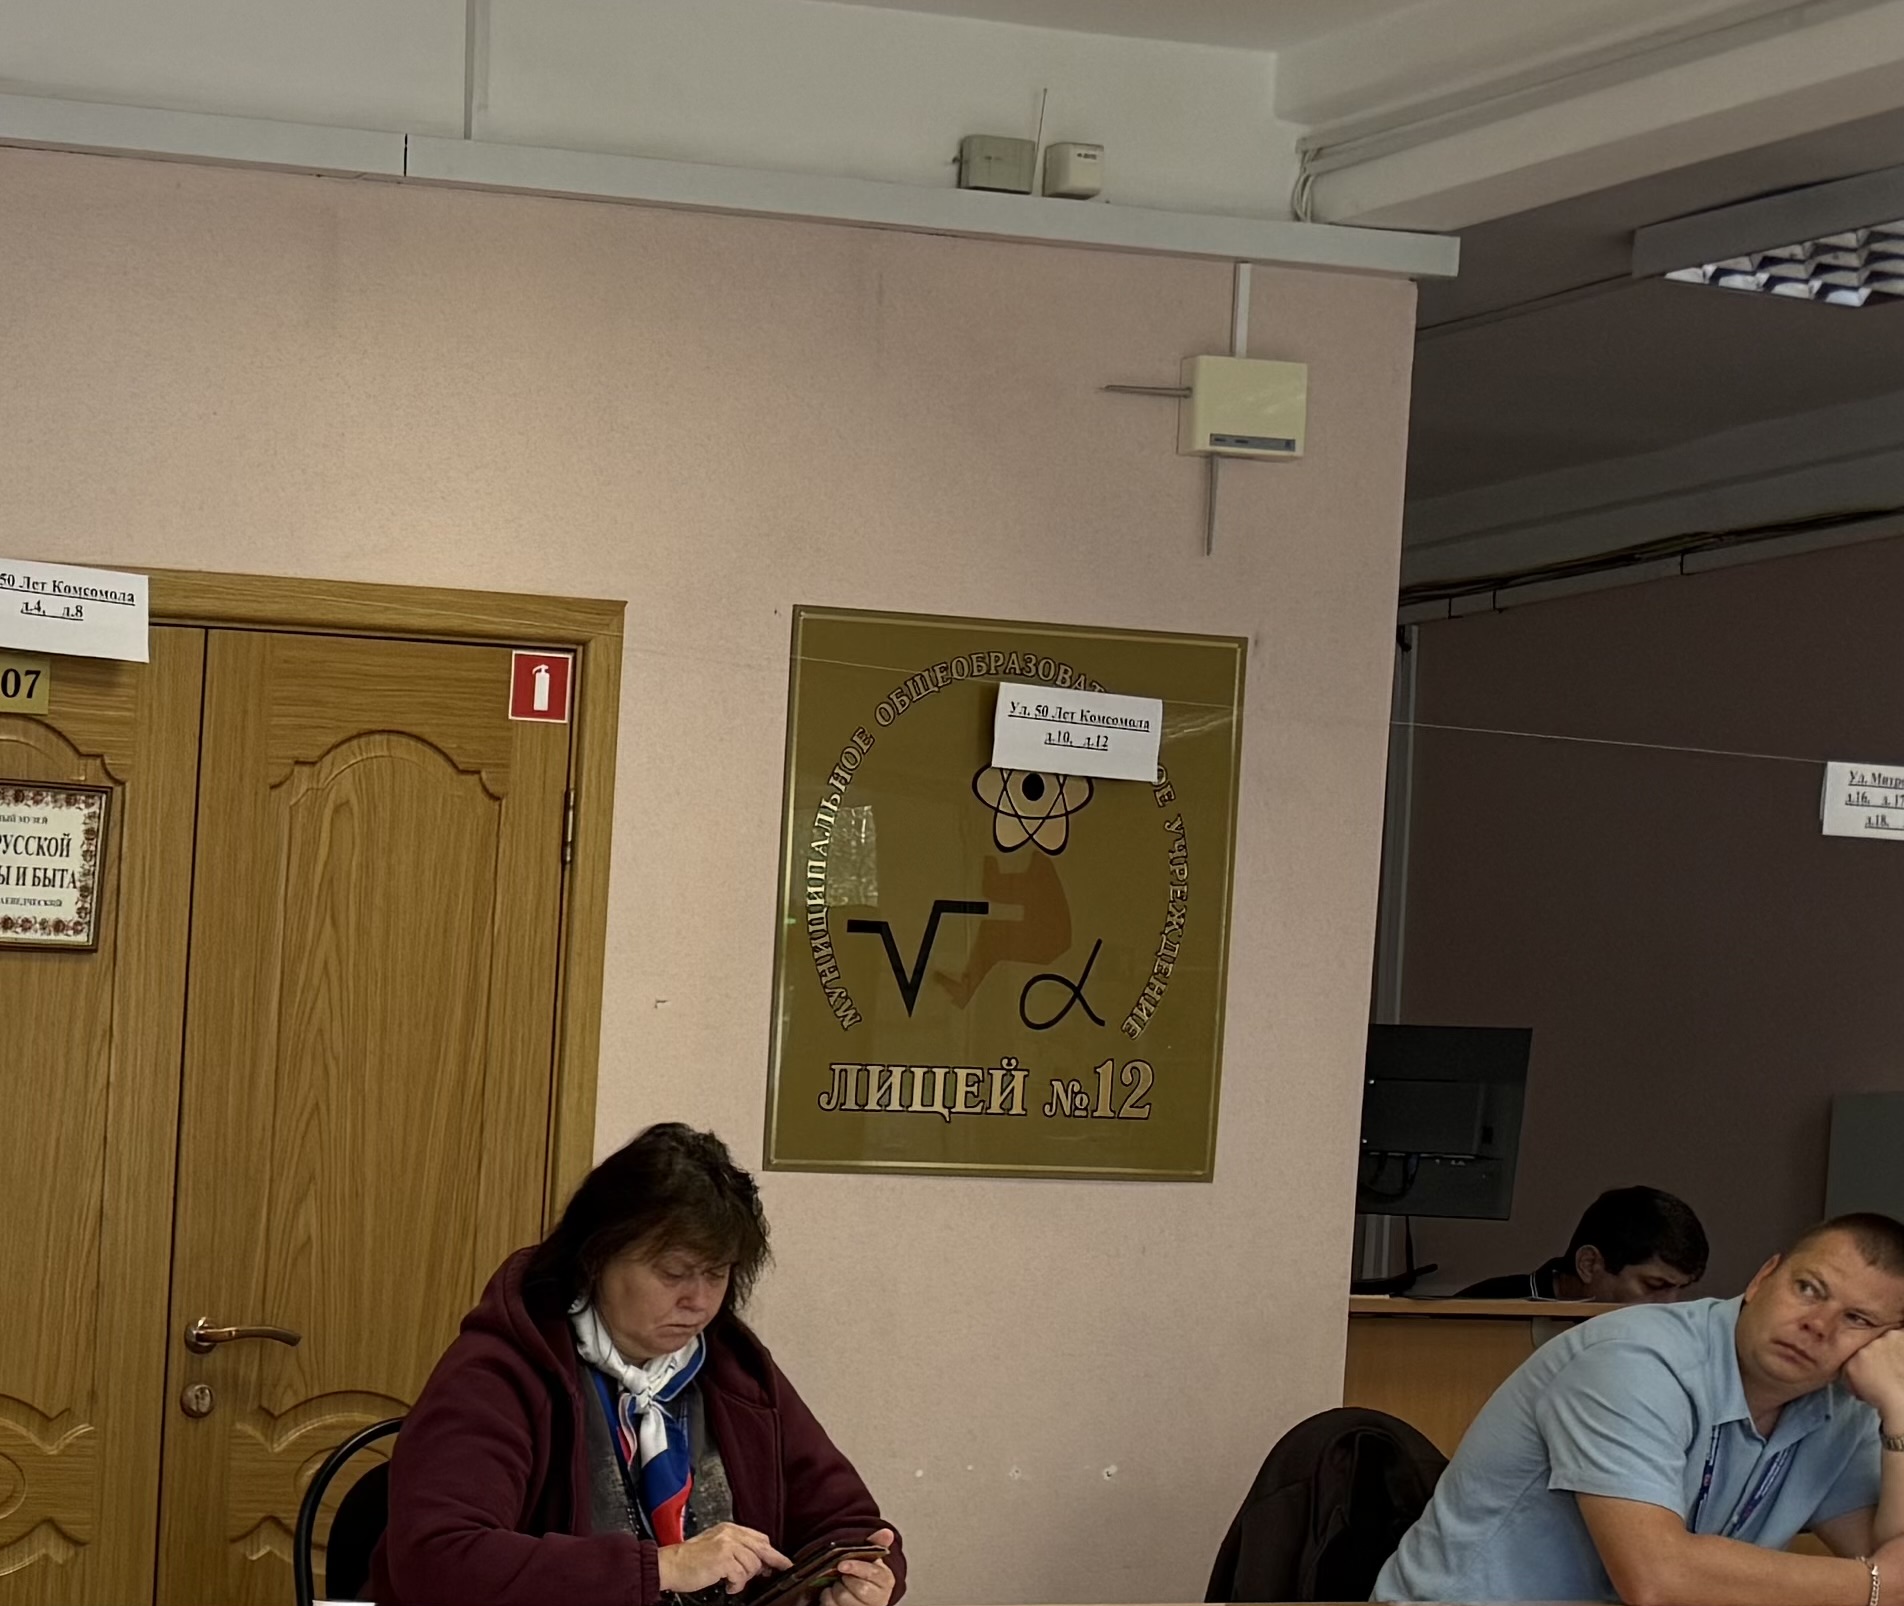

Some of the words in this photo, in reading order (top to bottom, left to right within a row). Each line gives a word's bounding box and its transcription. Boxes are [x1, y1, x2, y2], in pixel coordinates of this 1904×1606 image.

[0, 573, 16, 588] 50
[1035, 704, 1049, 718] 50
[1872, 772, 1904, 788] Митр
[15, 866, 27, 887] И
[31, 866, 78, 890] БЫТА
[805, 726, 875, 1031] МУНИЦИПАЛЬНОЕ
[1120, 813, 1189, 1040] УЧРЕЖДЕНИЕ
[818, 1057, 1029, 1123] ЛИЦЕЙ
[1043, 1058, 1154, 1121] №12
